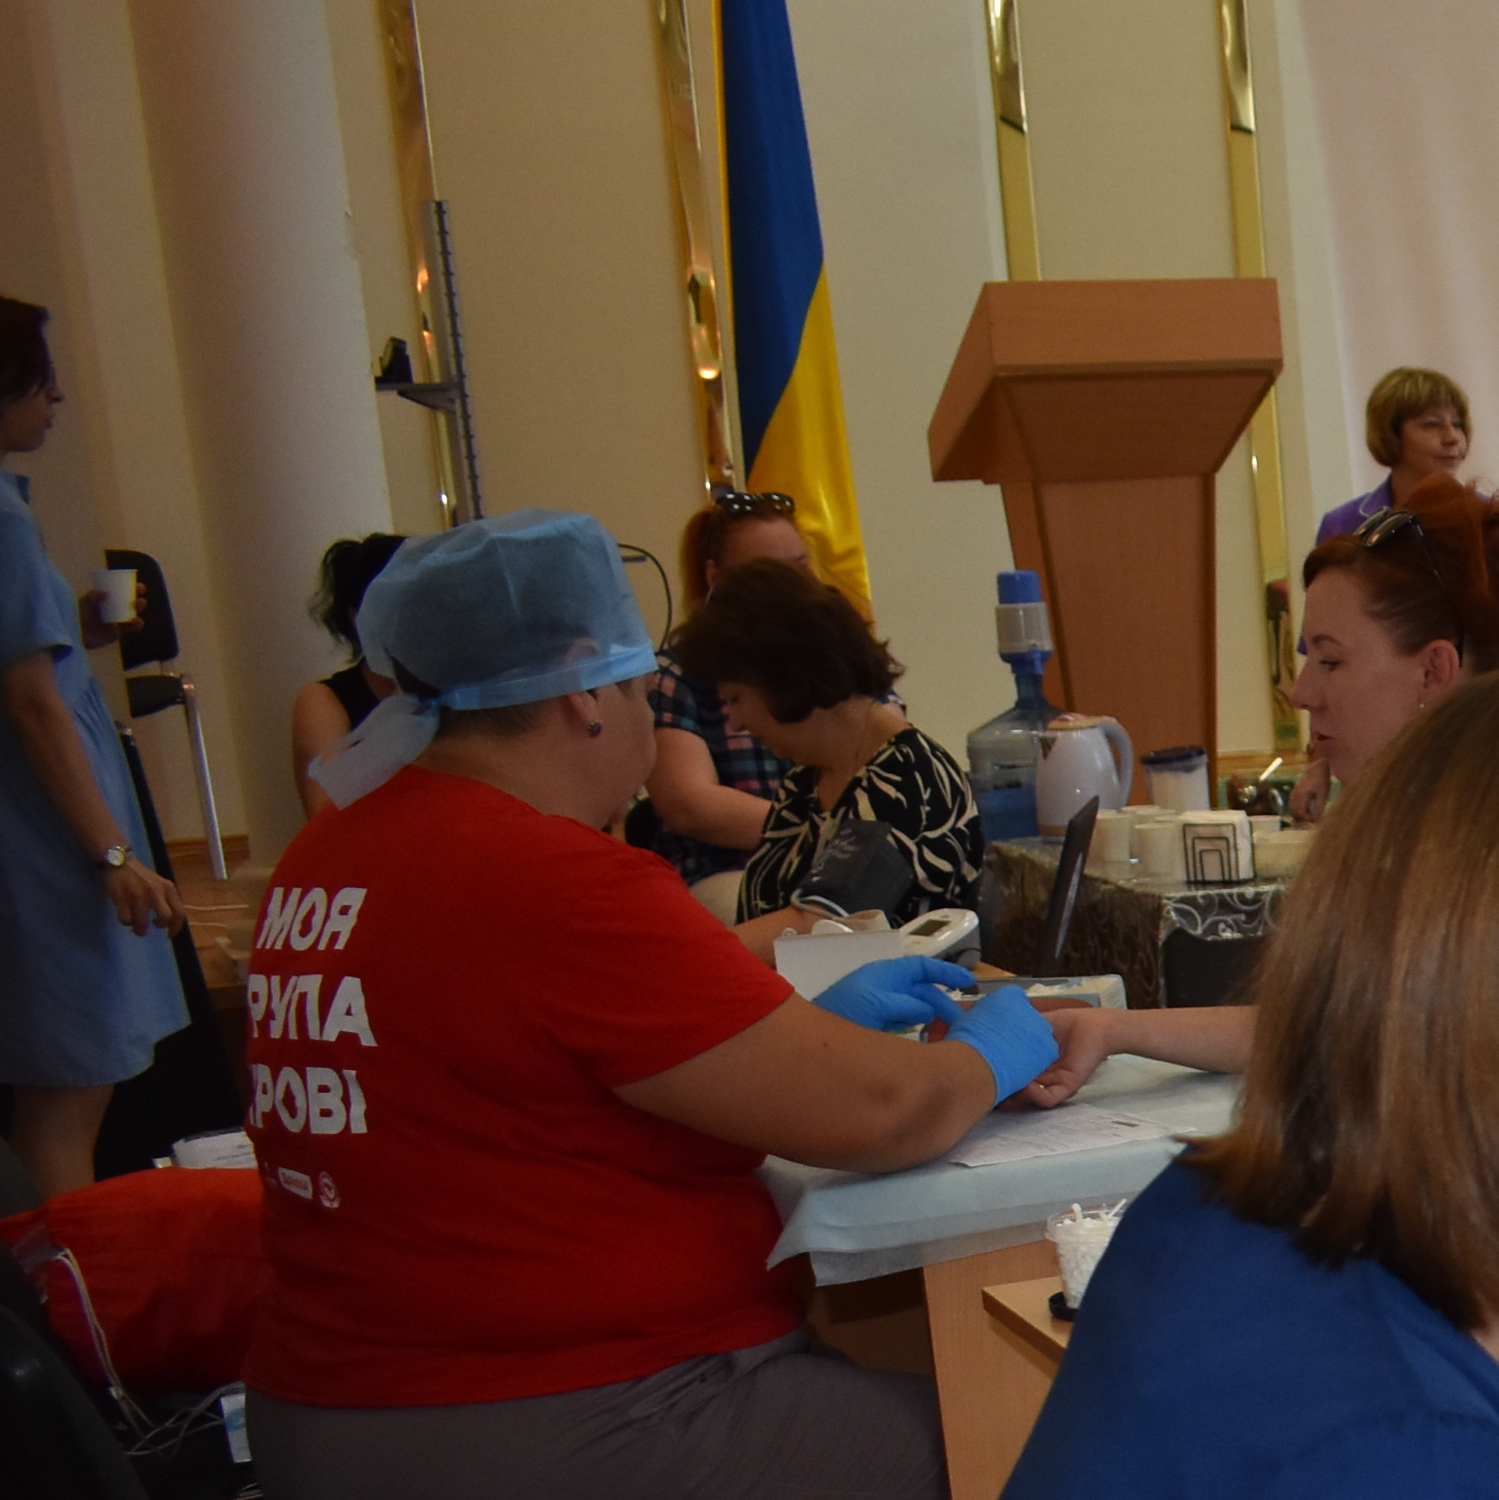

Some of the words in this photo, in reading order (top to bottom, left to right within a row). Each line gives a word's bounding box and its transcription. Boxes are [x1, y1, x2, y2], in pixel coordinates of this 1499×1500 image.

[256, 887, 368, 951] МОЯ
[248, 974, 378, 1047] РУПА
[250, 1063, 368, 1135] РОВІ
